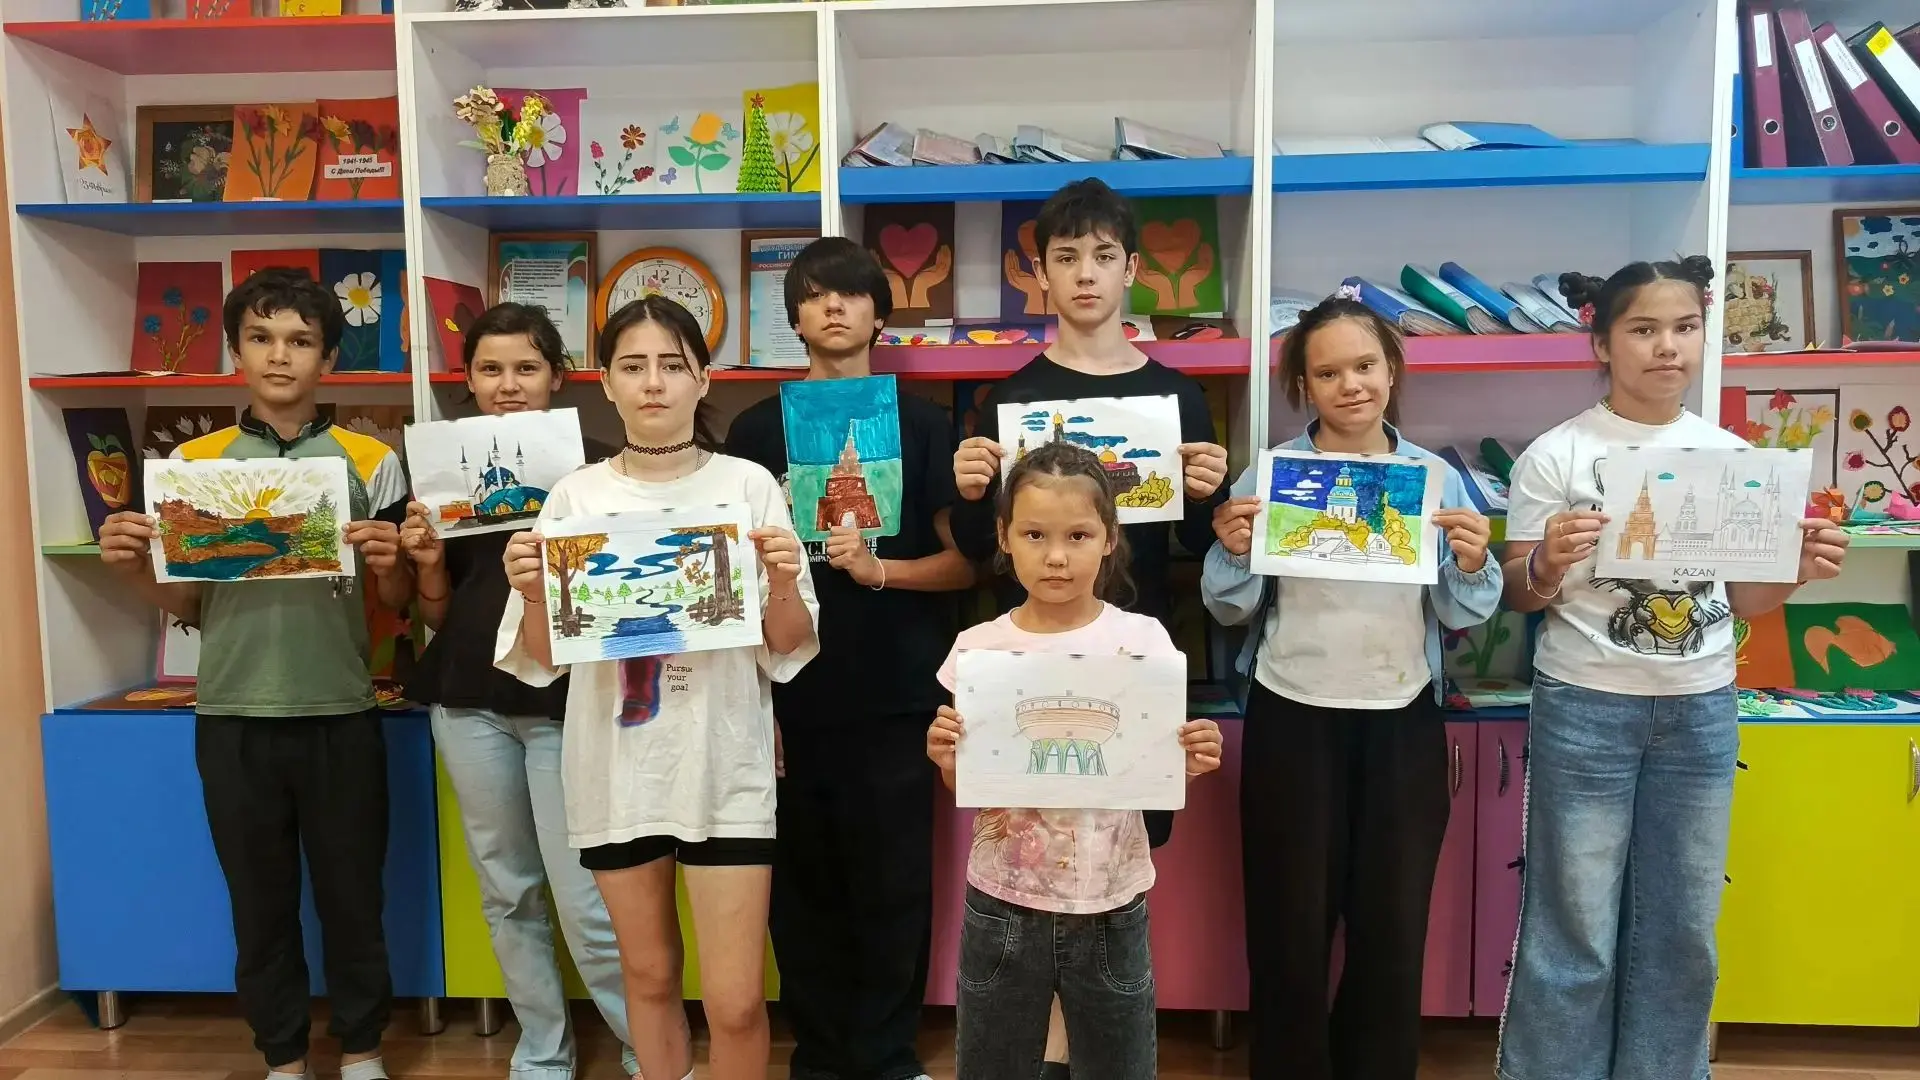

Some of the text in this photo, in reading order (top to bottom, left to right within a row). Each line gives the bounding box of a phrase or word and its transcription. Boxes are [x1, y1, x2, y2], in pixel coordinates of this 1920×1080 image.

[778, 251, 800, 260] ГИМ
[623, 288, 637, 300] 10
[694, 306, 704, 318] 3
[1673, 567, 1716, 577] KAZAN
[667, 674, 686, 682] your
[671, 683, 688, 692] goal
